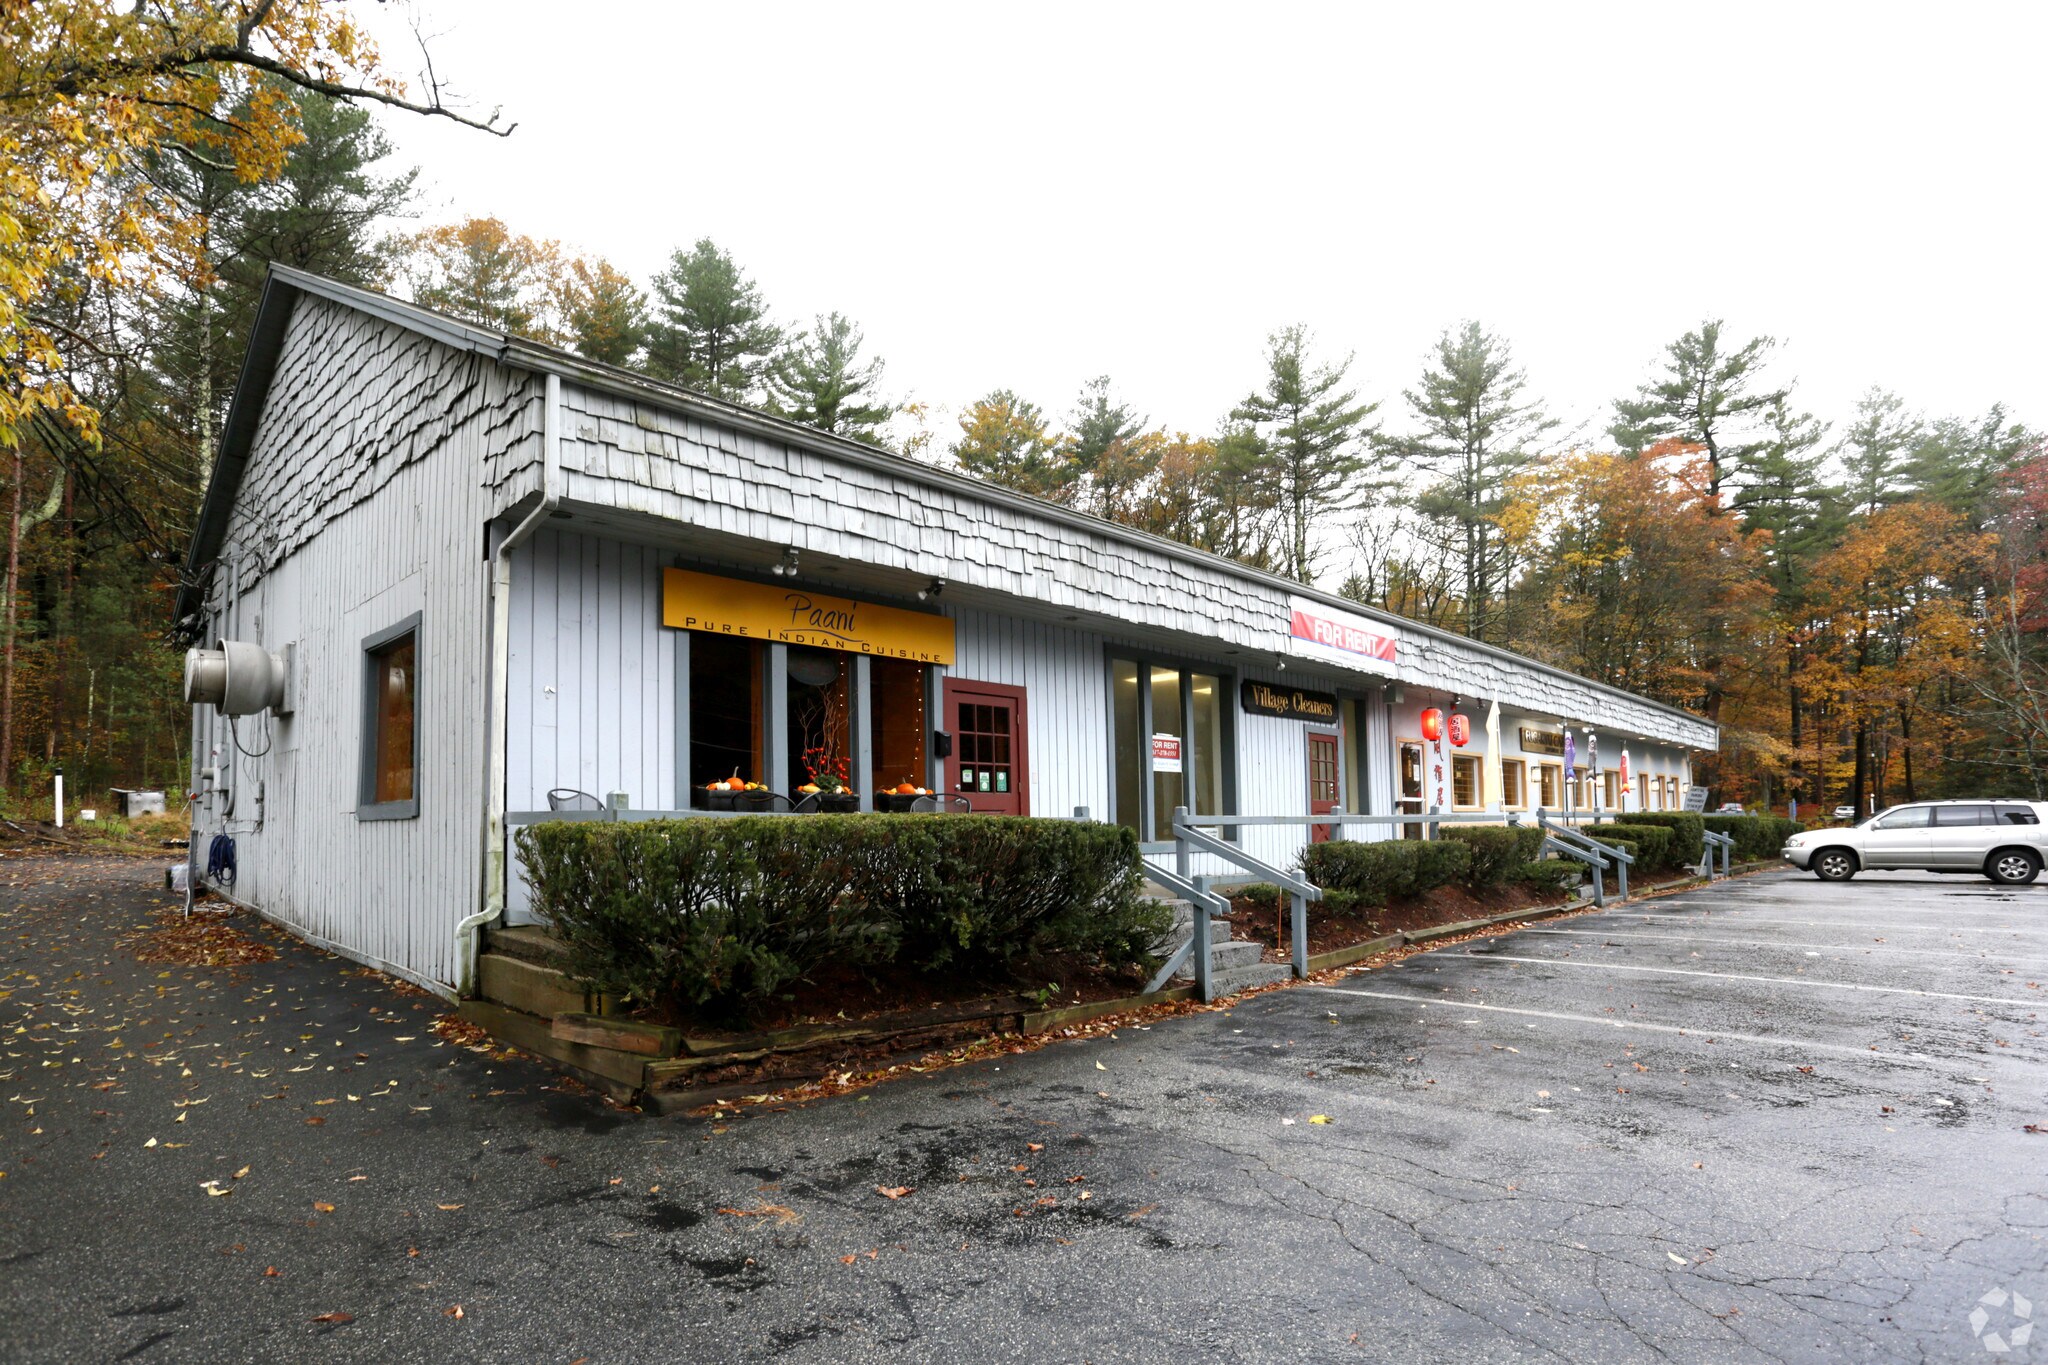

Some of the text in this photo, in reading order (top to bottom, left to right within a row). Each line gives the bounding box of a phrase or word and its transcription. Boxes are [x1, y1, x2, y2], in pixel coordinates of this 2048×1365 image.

[785, 594, 856, 632] Paani
[685, 616, 941, 662] PURE INDIAN CUISINE
[1314, 619, 1378, 655] FOR RENT
[1252, 685, 1333, 716] Village Cleaners
[1164, 741, 1178, 750] RENT
